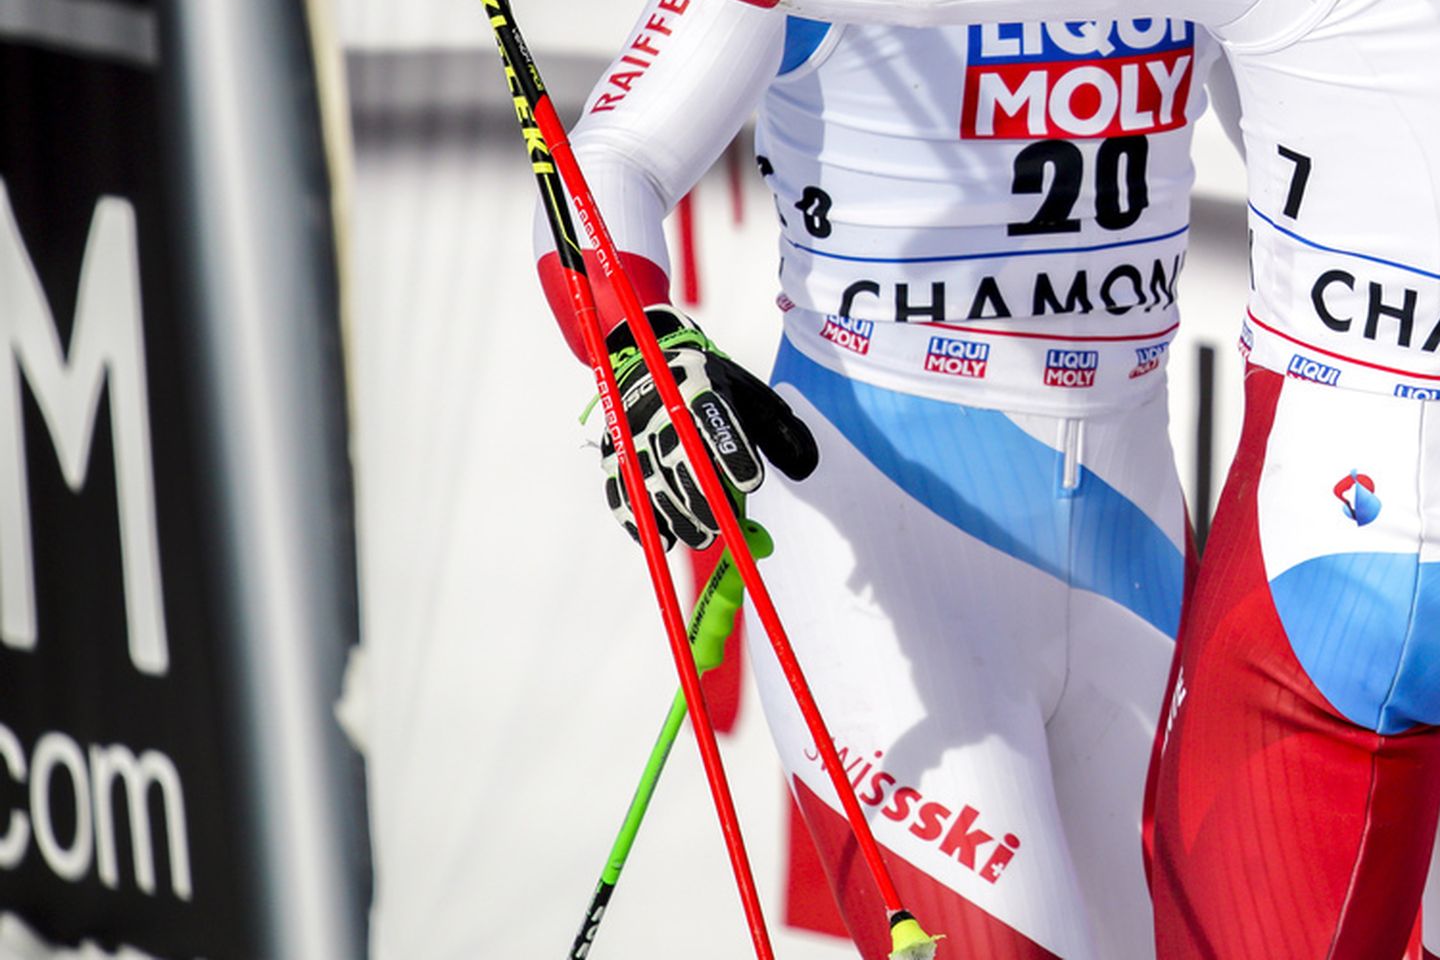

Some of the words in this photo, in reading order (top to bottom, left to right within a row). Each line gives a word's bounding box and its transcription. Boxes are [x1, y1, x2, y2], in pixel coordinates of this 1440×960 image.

[975, 55, 1191, 137] MOLY
[1007, 134, 1149, 237] 20
[1276, 144, 1312, 221] 7
[823, 324, 869, 354] MOLY
[930, 339, 988, 360] LIQUI
[926, 357, 985, 378] MOLY
[1048, 351, 1097, 368] LIQUI
[1289, 357, 1341, 386] LIQUI
[1046, 369, 1094, 387] MOLY
[702, 402, 738, 455] racing
